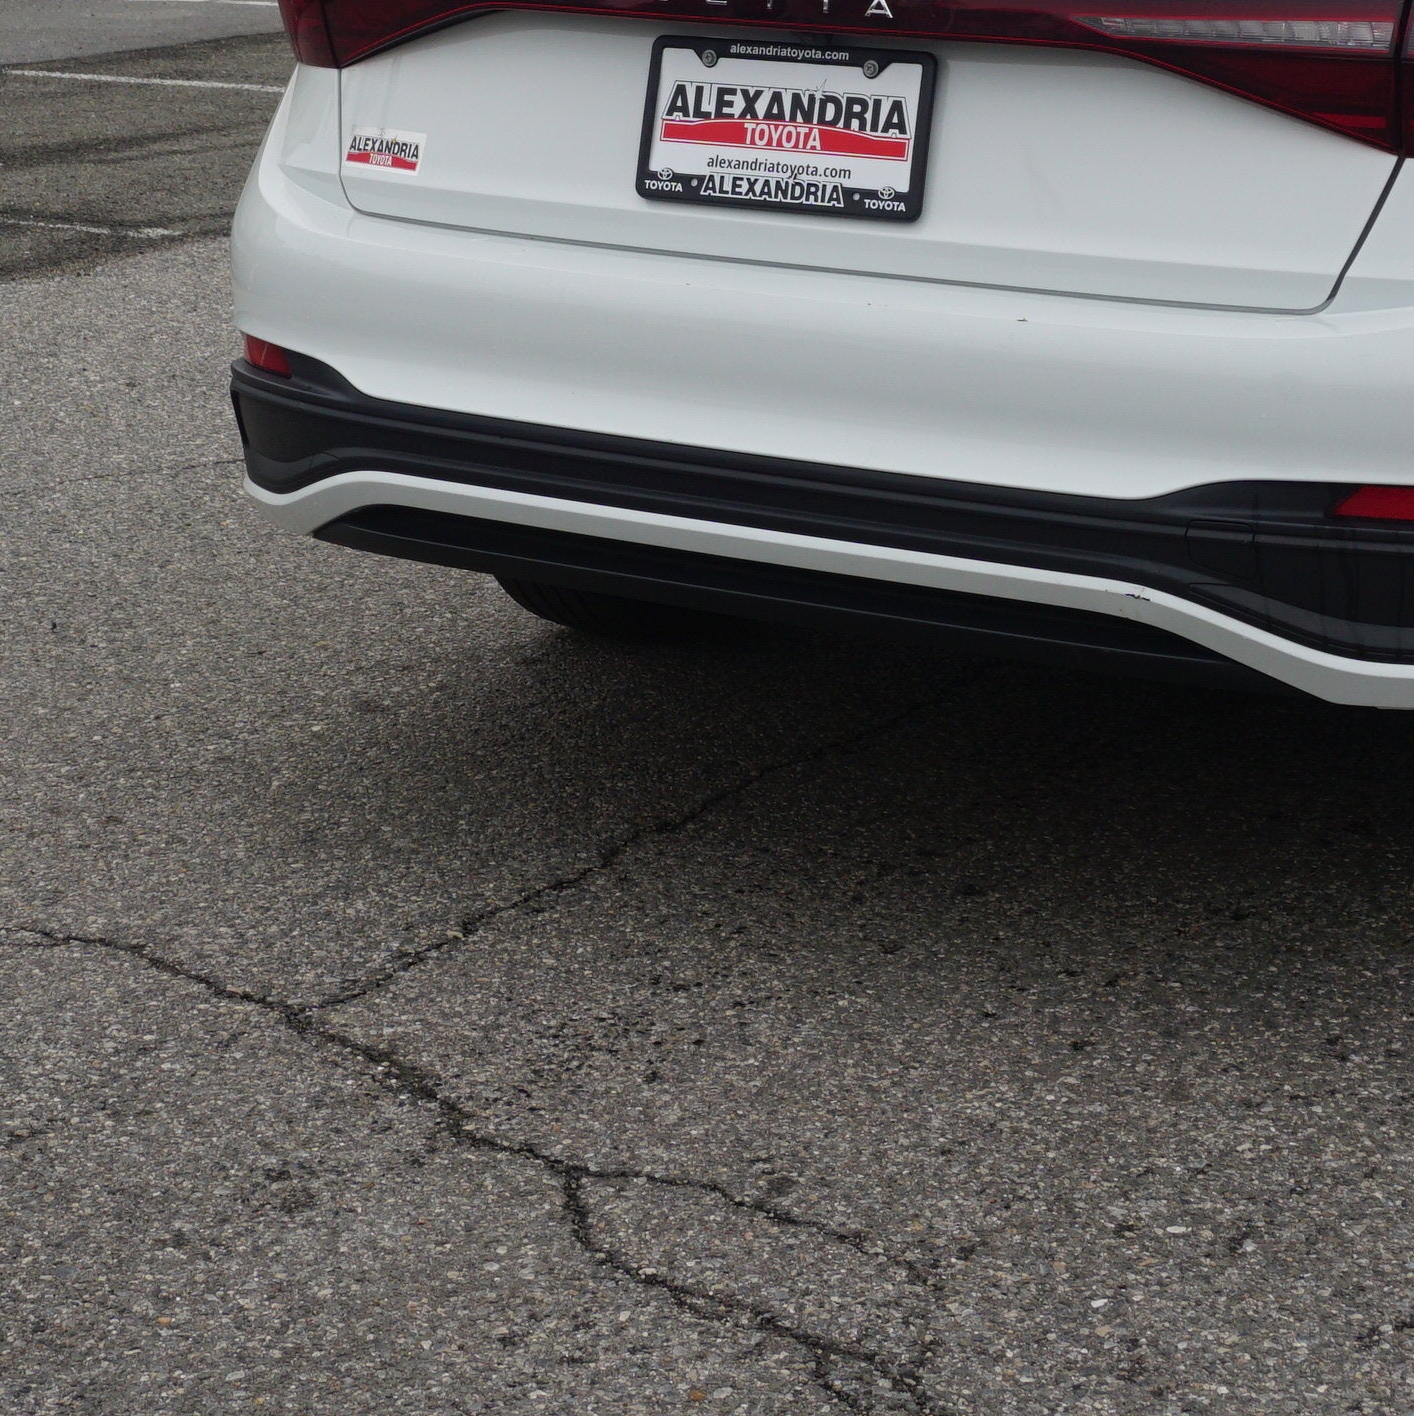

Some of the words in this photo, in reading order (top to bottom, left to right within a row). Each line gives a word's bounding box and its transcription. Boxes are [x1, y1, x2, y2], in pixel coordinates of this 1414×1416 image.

[730, 43, 849, 61] alexandriatoyota.com
[663, 81, 910, 136] ALEXANDRIA
[349, 135, 419, 160] ALEXANDRIA
[743, 122, 821, 151] TOYOTA
[369, 153, 392, 166] TOYOTA
[707, 154, 851, 180] alexandriatoyota.com
[644, 179, 683, 192] TOYOTA
[701, 173, 844, 208] ALEXANDRIA
[864, 198, 906, 213] TOYOTA
